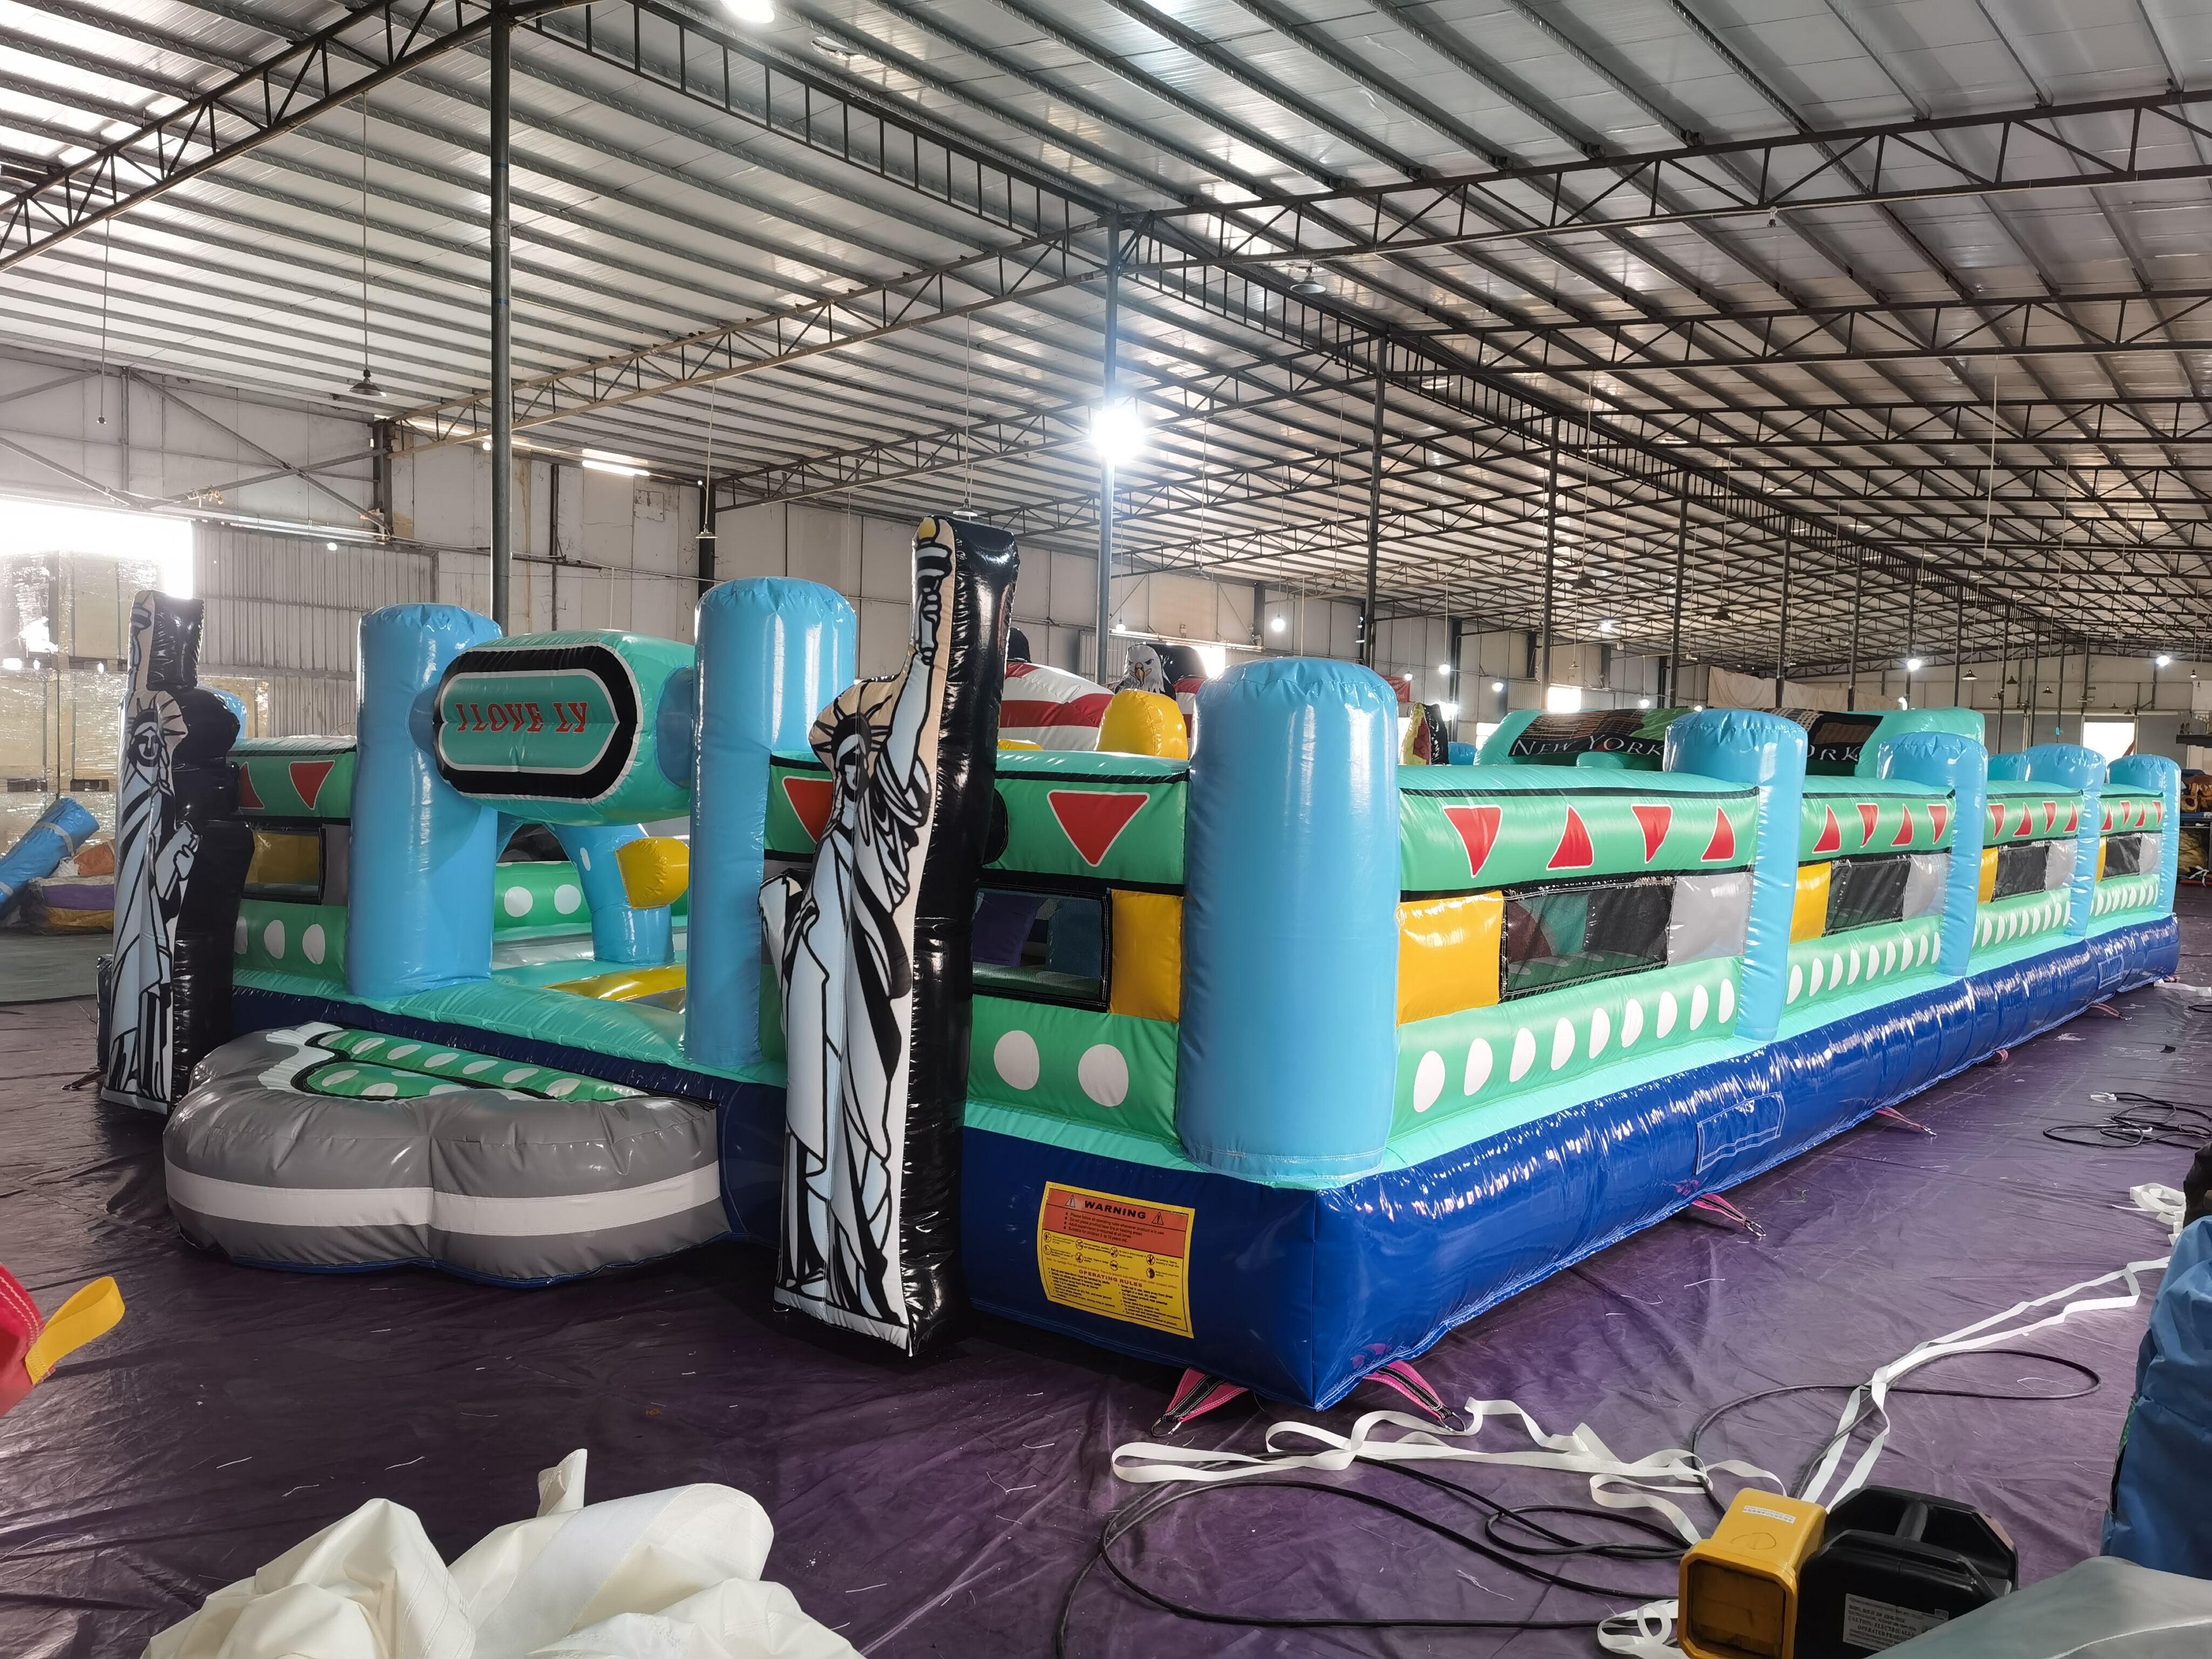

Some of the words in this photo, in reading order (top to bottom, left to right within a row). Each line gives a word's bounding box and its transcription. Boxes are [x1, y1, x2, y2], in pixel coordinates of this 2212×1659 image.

[469, 702, 544, 733] LOVE
[1512, 739, 1577, 756] NEW
[1588, 734, 1664, 756] YORK
[1085, 1201, 1146, 1219] WARNING
[1079, 1269, 1117, 1283] OPERATING
[1120, 1278, 1143, 1288] RULES
